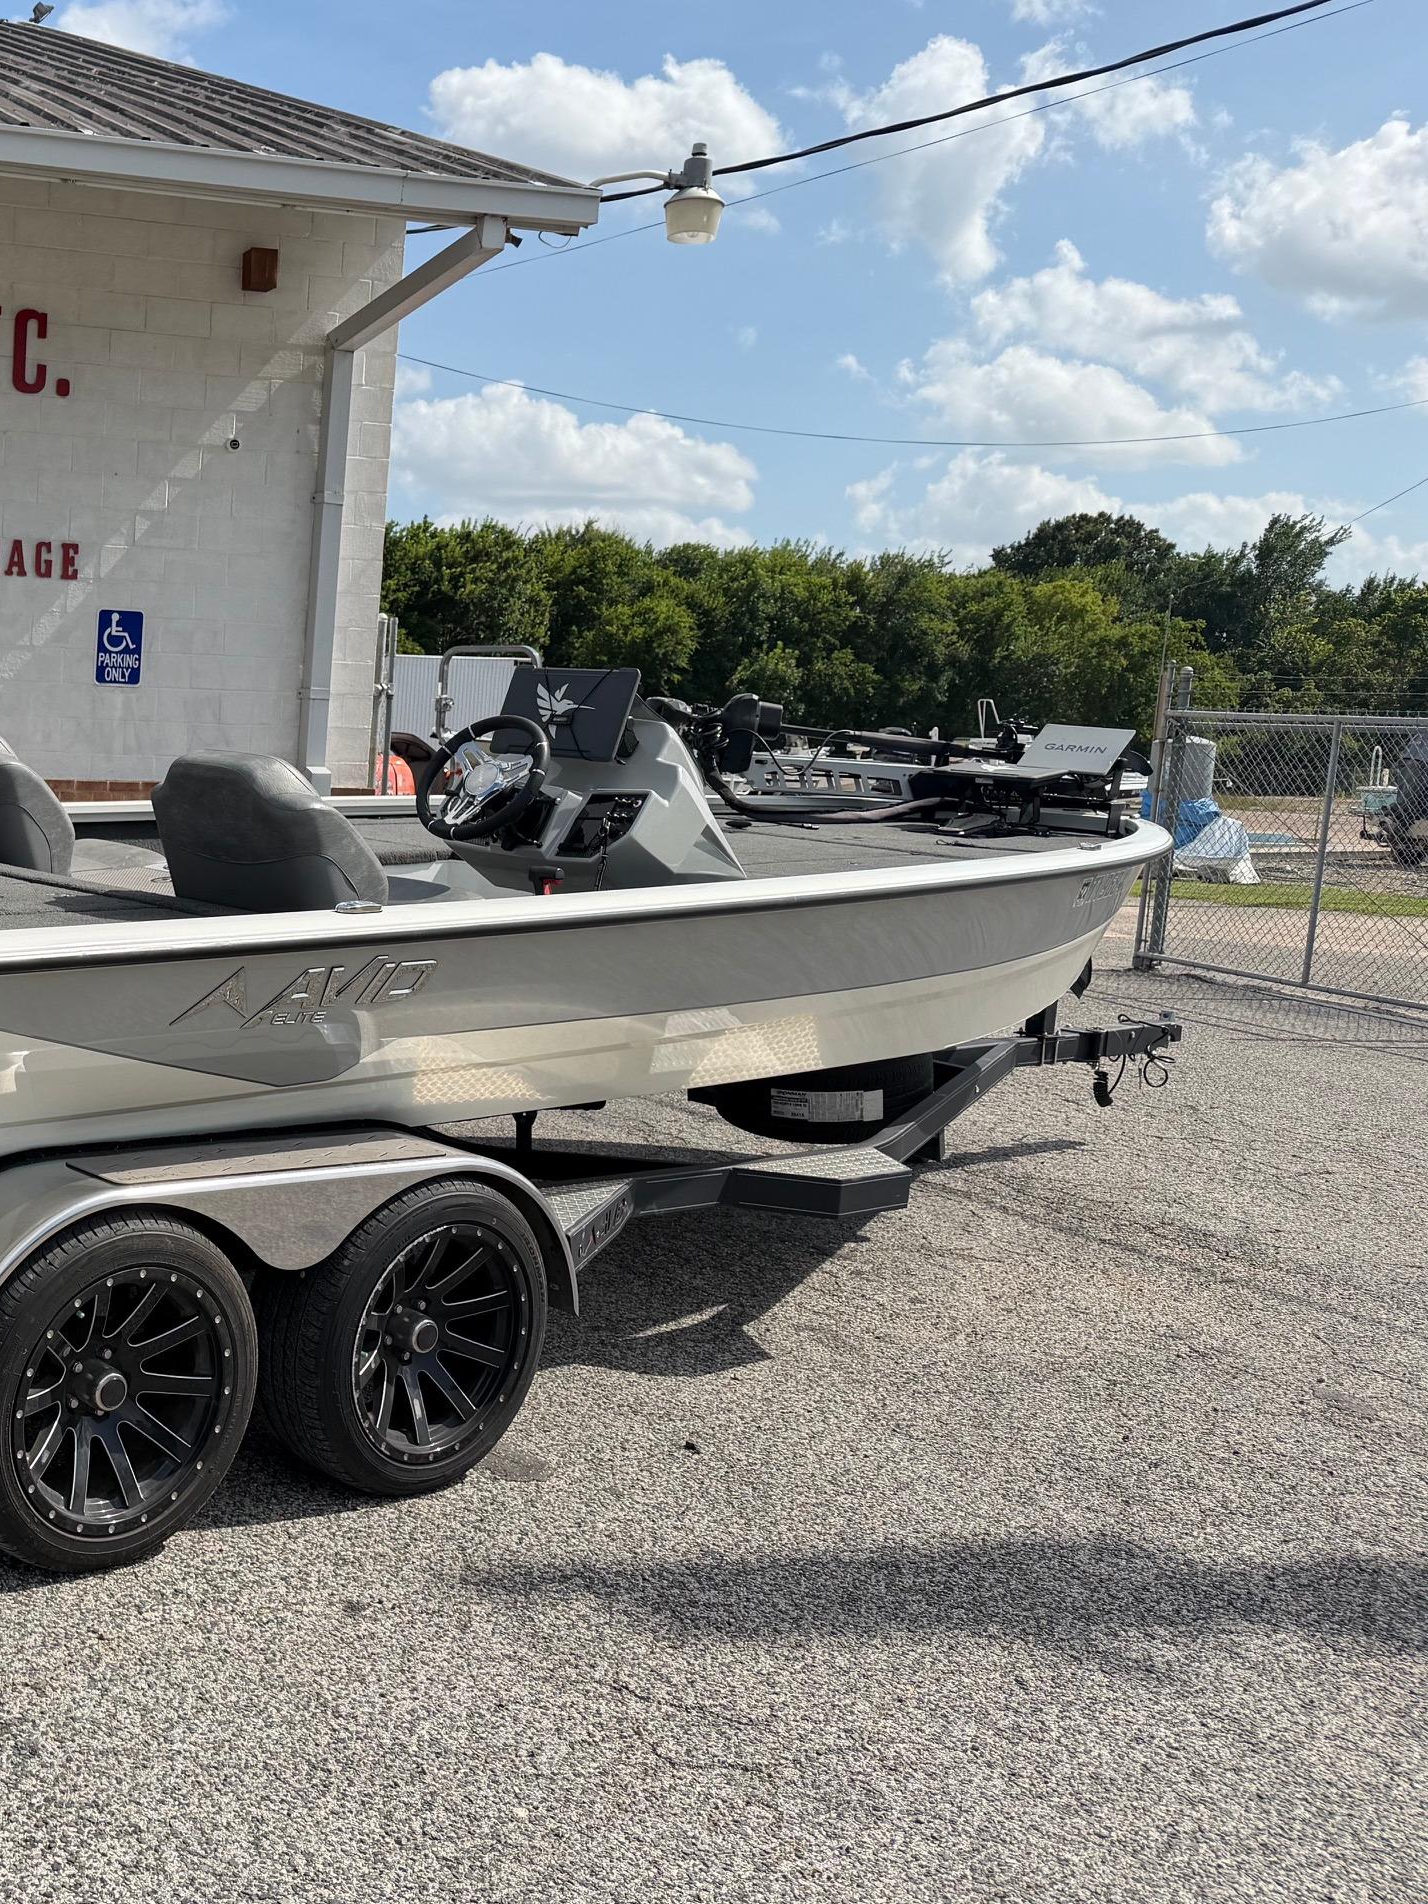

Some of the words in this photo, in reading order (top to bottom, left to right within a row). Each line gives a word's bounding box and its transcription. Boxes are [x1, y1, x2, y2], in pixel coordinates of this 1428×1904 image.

[98, 652, 139, 668] PARKING
[104, 667, 132, 682] ONLY
[1044, 743, 1108, 754] GARMIN
[271, 1011, 327, 1025] ELITE
